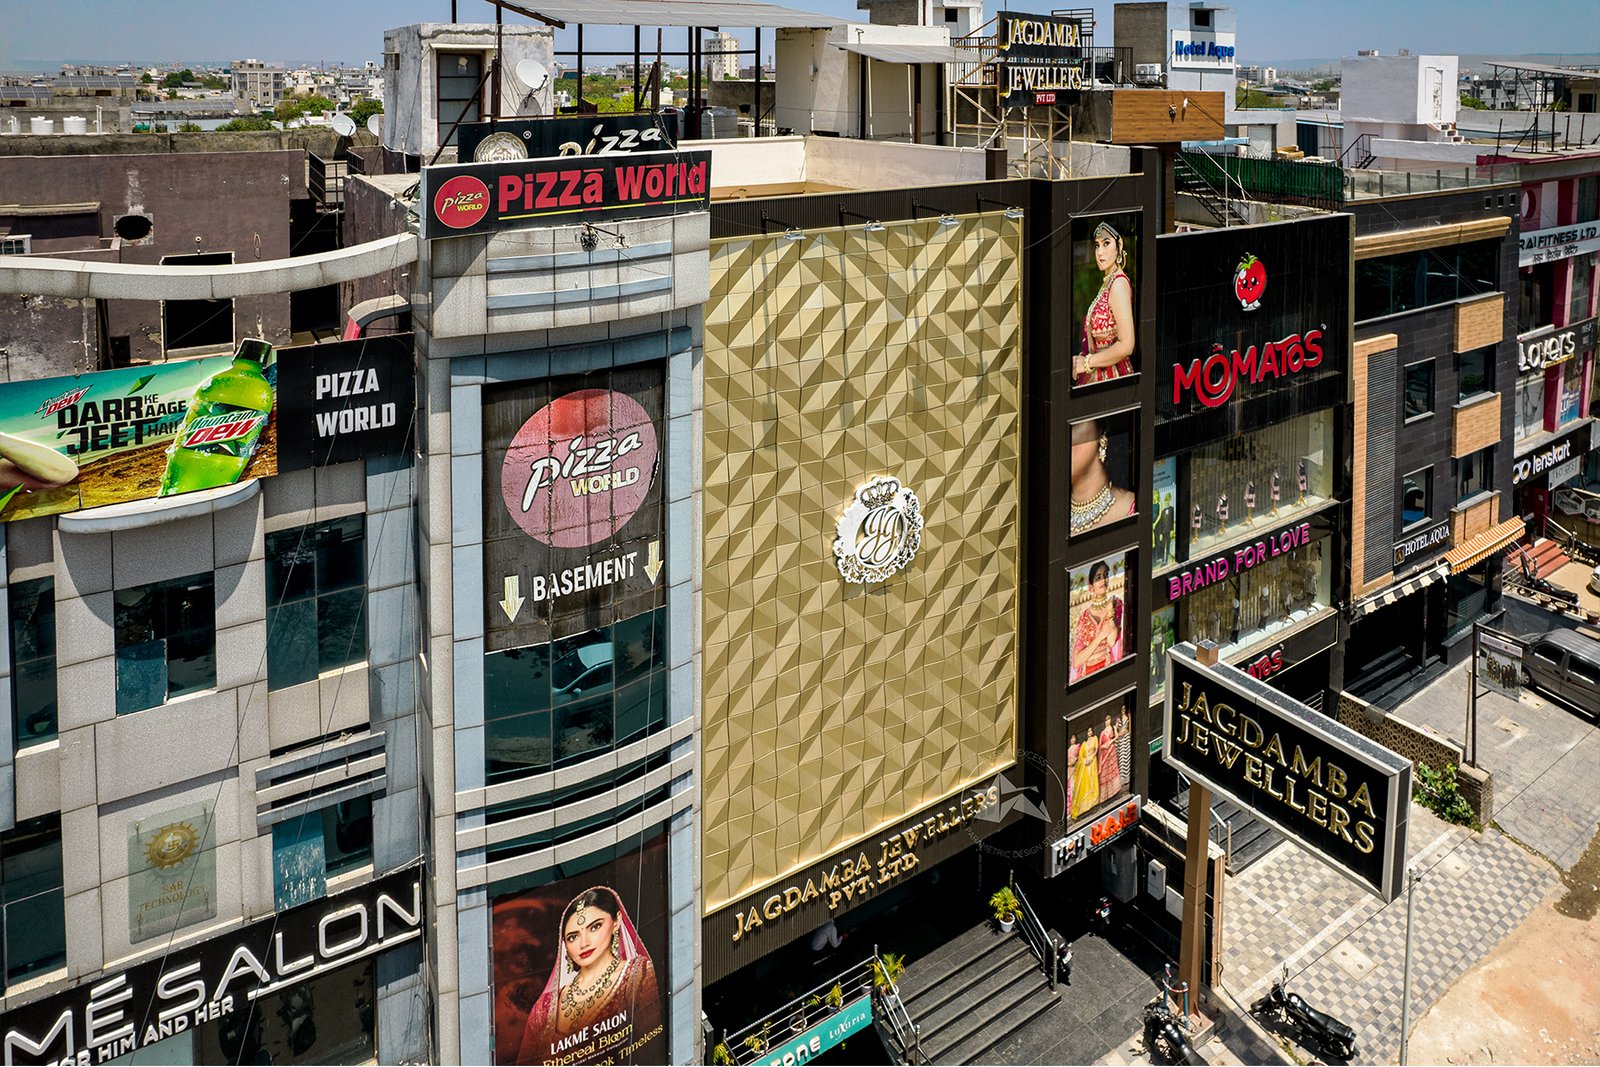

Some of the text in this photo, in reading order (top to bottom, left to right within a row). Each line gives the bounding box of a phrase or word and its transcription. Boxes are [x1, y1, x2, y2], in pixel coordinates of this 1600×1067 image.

[1006, 18, 1081, 51] JAGDAMBA
[1174, 40, 1235, 60] Hotel Aqua
[1006, 65, 1083, 99] JEWELLERS
[439, 190, 483, 215] pizza
[456, 203, 483, 213] WORLD
[1537, 229, 1578, 248] FITNESS
[1580, 226, 1597, 240] LTD
[314, 366, 381, 402] PIZZA
[56, 393, 159, 430] DARR KE
[145, 400, 188, 418] AAGE
[185, 410, 256, 434] Mountain
[314, 401, 397, 439] WORLD
[66, 416, 161, 455] JEET
[521, 435, 643, 513] pizza
[1532, 439, 1571, 475] lenskart
[569, 467, 641, 497] WORLD
[1404, 525, 1450, 557] HOTEL AQUA
[532, 553, 637, 602] BASEMENT
[1168, 523, 1311, 601] BRAND FOR LOVE
[1177, 680, 1377, 819] JAGDAMBA
[1176, 713, 1376, 855] JEWELLERS
[732, 785, 999, 941] JAGDAMBA JEWELLERS
[828, 853, 919, 910] PVT. LTD
[158, 881, 420, 1023] SALON
[97, 1031, 137, 1063] HIM
[143, 1015, 189, 1047] AND
[194, 995, 235, 1026] HER
[550, 1026, 589, 1056] LAKME
[592, 1009, 628, 1038] SALON
[598, 1024, 633, 1050] Bloom
